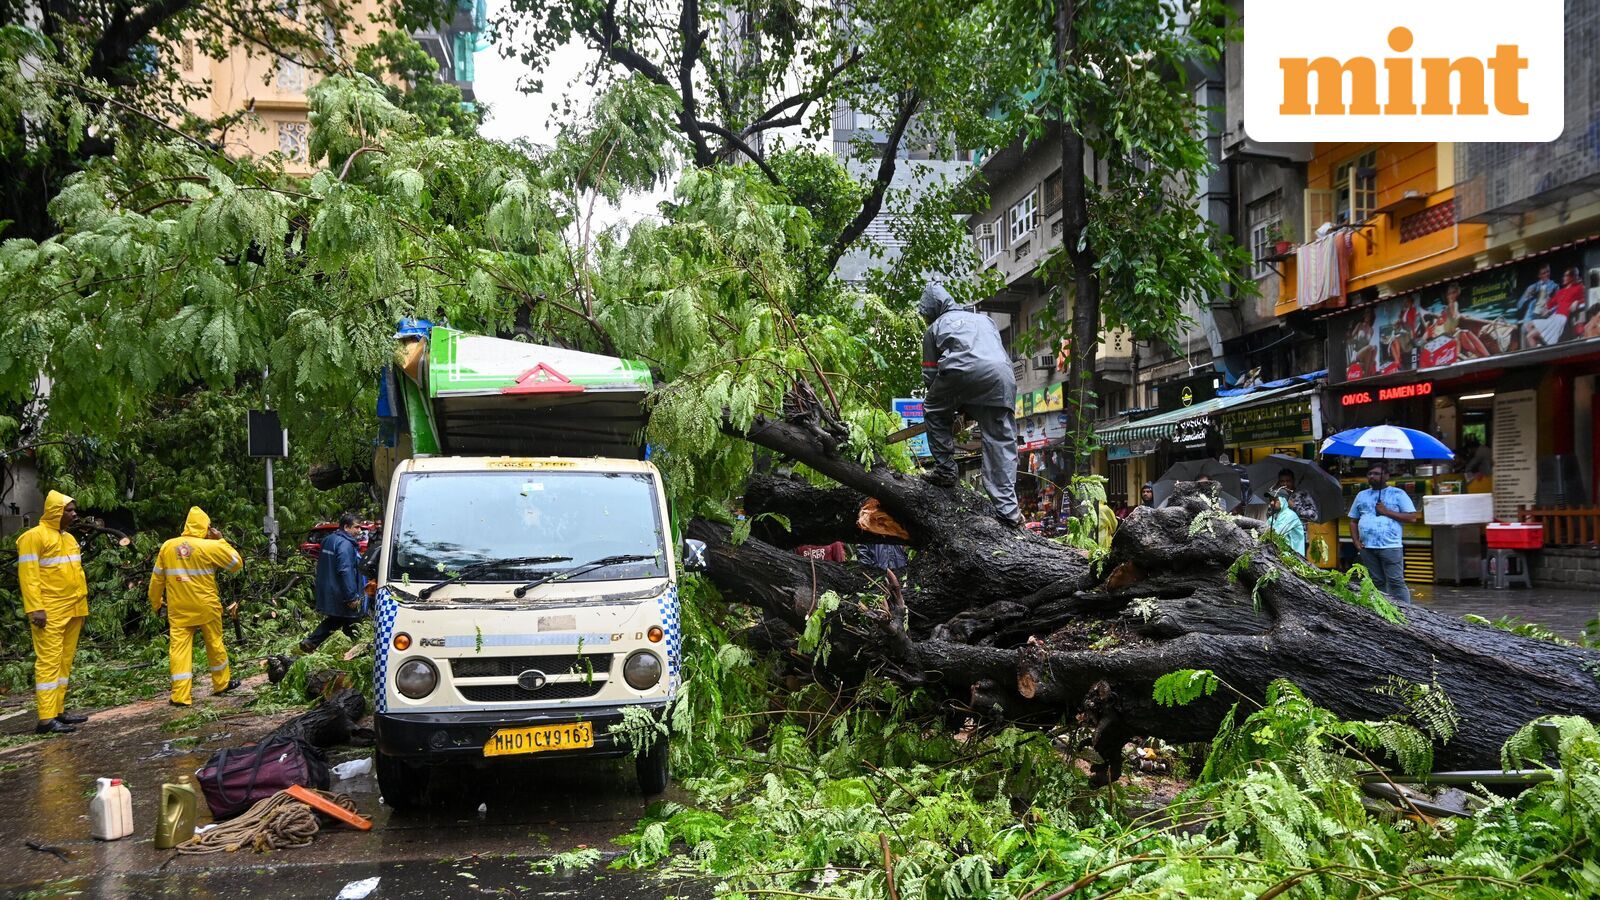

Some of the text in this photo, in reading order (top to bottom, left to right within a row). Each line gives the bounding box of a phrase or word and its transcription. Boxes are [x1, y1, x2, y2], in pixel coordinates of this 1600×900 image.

[1379, 385, 1415, 401] RAMEN
[611, 632, 644, 642] GD
[495, 727, 590, 751] MH01CV9163
